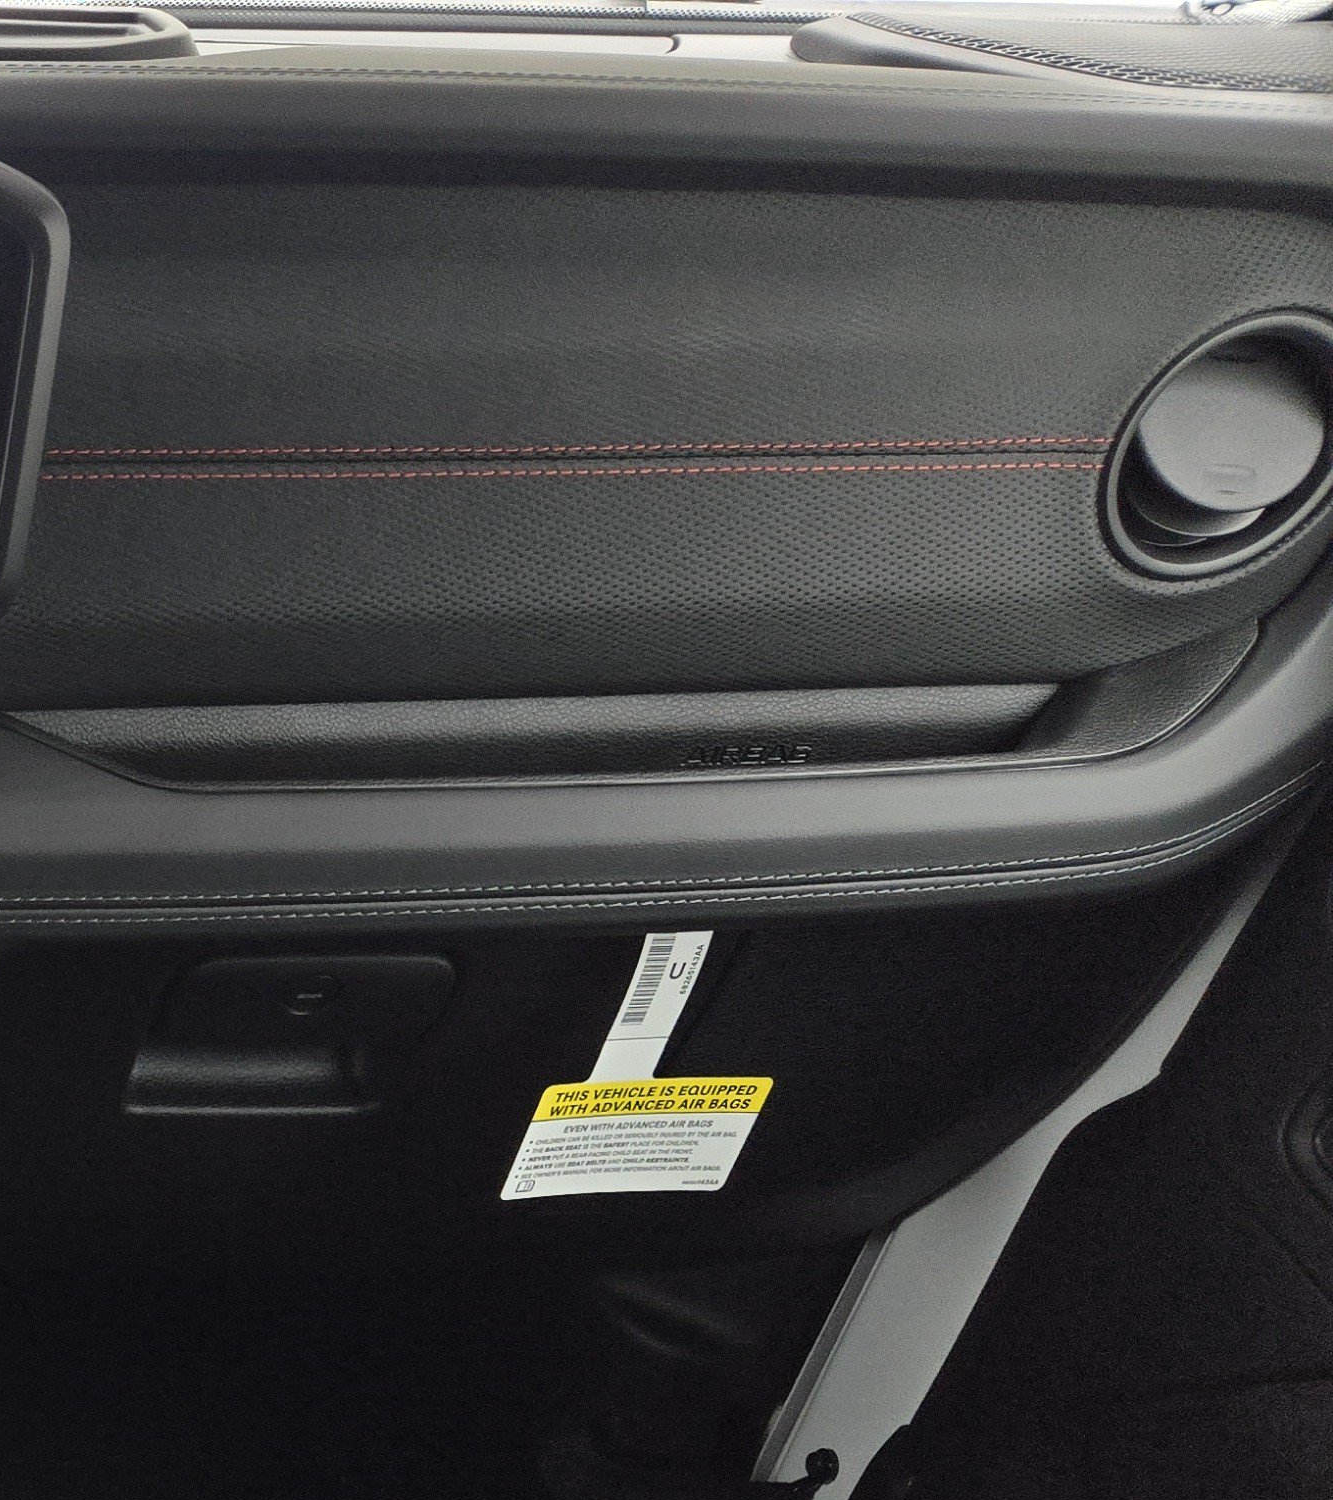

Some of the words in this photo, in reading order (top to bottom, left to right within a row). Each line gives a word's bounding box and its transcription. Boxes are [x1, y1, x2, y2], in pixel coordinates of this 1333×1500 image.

[669, 962, 687, 979] U
[555, 1090, 590, 1103] THIS
[593, 1086, 658, 1100] VEHICLE
[659, 1085, 676, 1097] IS
[678, 1084, 758, 1096] EQUIPPED
[549, 1103, 589, 1117] WITH
[590, 1099, 676, 1113] ADVANCED
[677, 1099, 706, 1110] AIR
[708, 1098, 752, 1110] BAGS
[564, 1124, 589, 1133] EVEN
[590, 1122, 614, 1131] WITH
[615, 1121, 668, 1130] ADVANCED
[687, 1120, 713, 1128] BAGS
